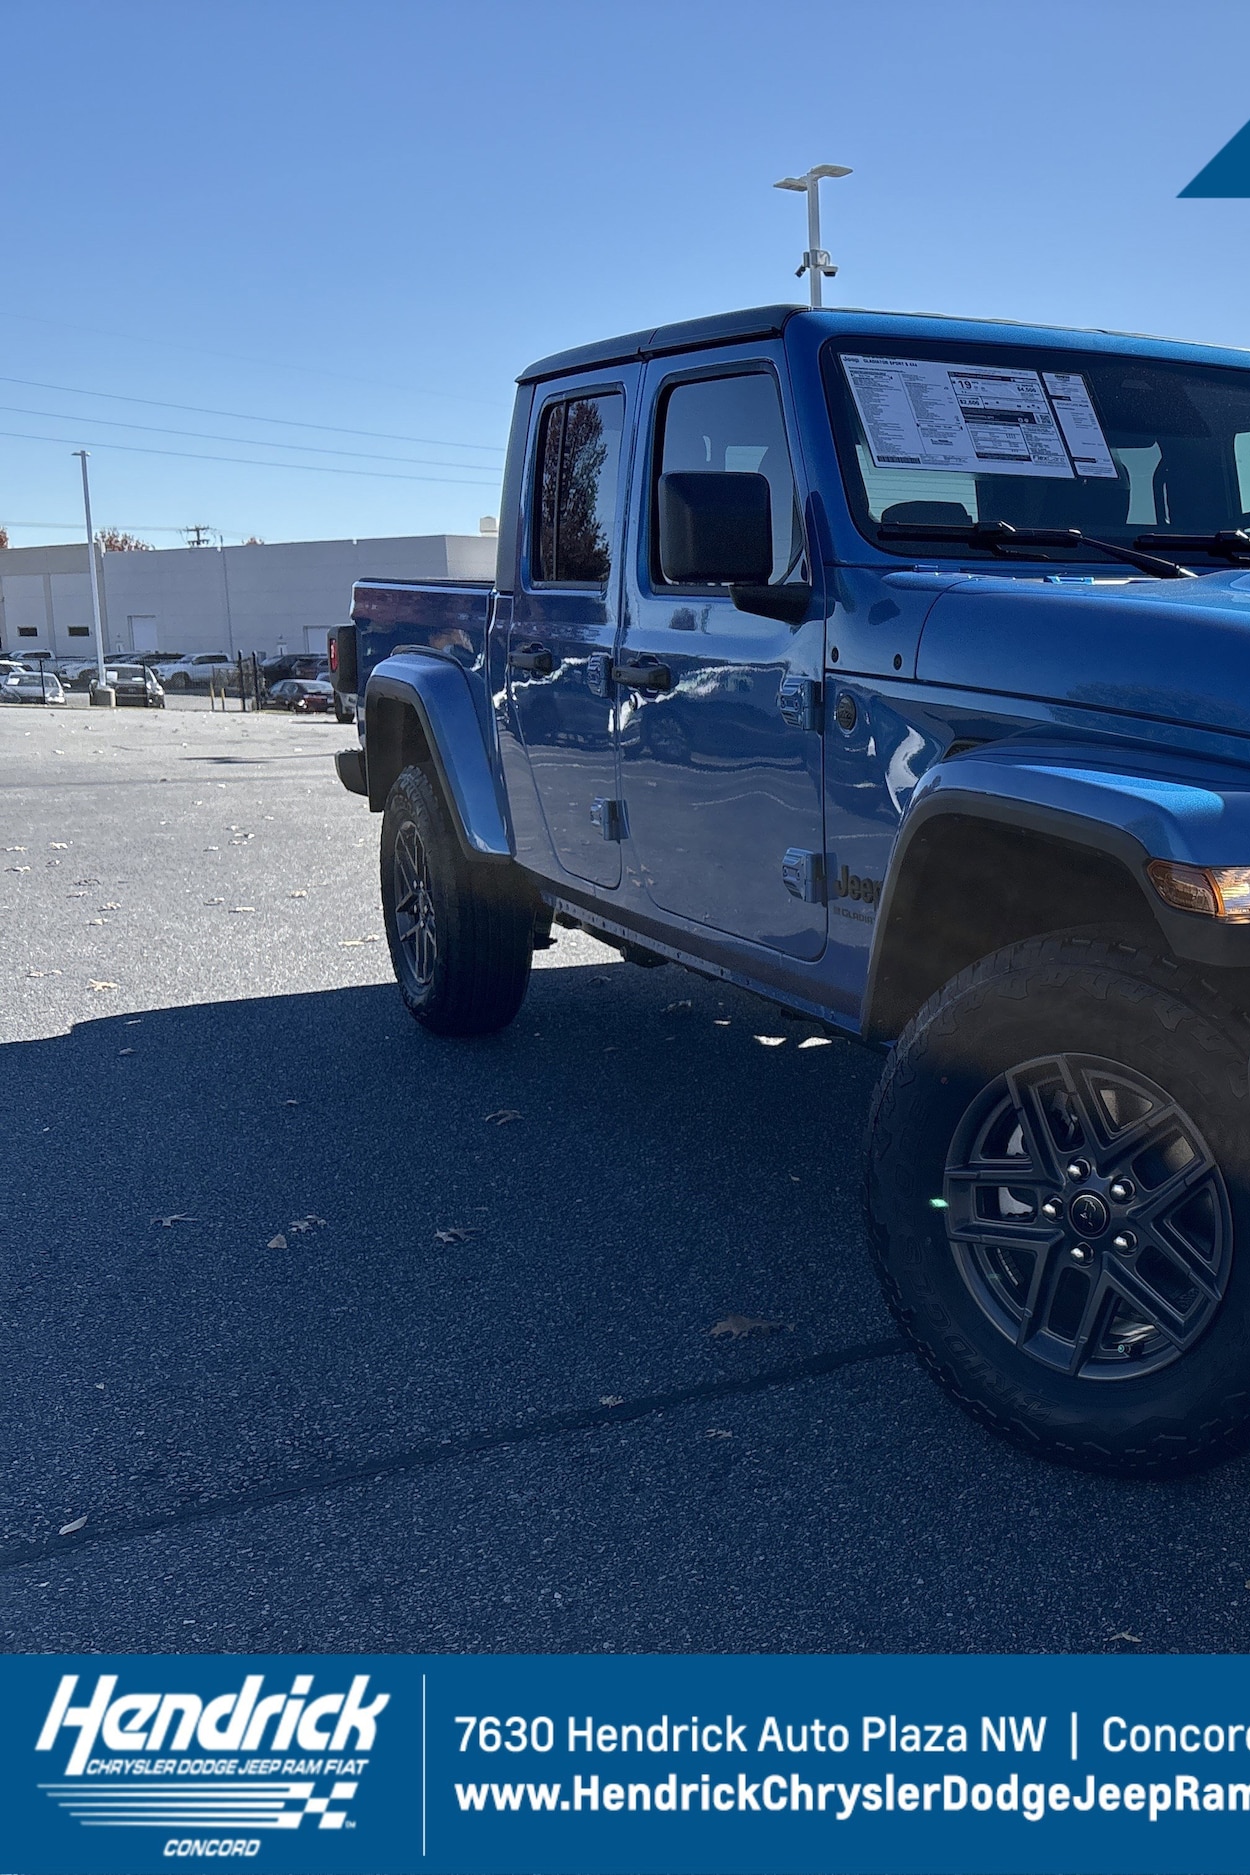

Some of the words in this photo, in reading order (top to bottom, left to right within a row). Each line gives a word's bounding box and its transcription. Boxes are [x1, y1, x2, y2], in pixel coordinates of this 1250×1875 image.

[958, 380, 972, 389] 19
[834, 864, 883, 911] Jeep
[842, 908, 875, 925] GLADIA
